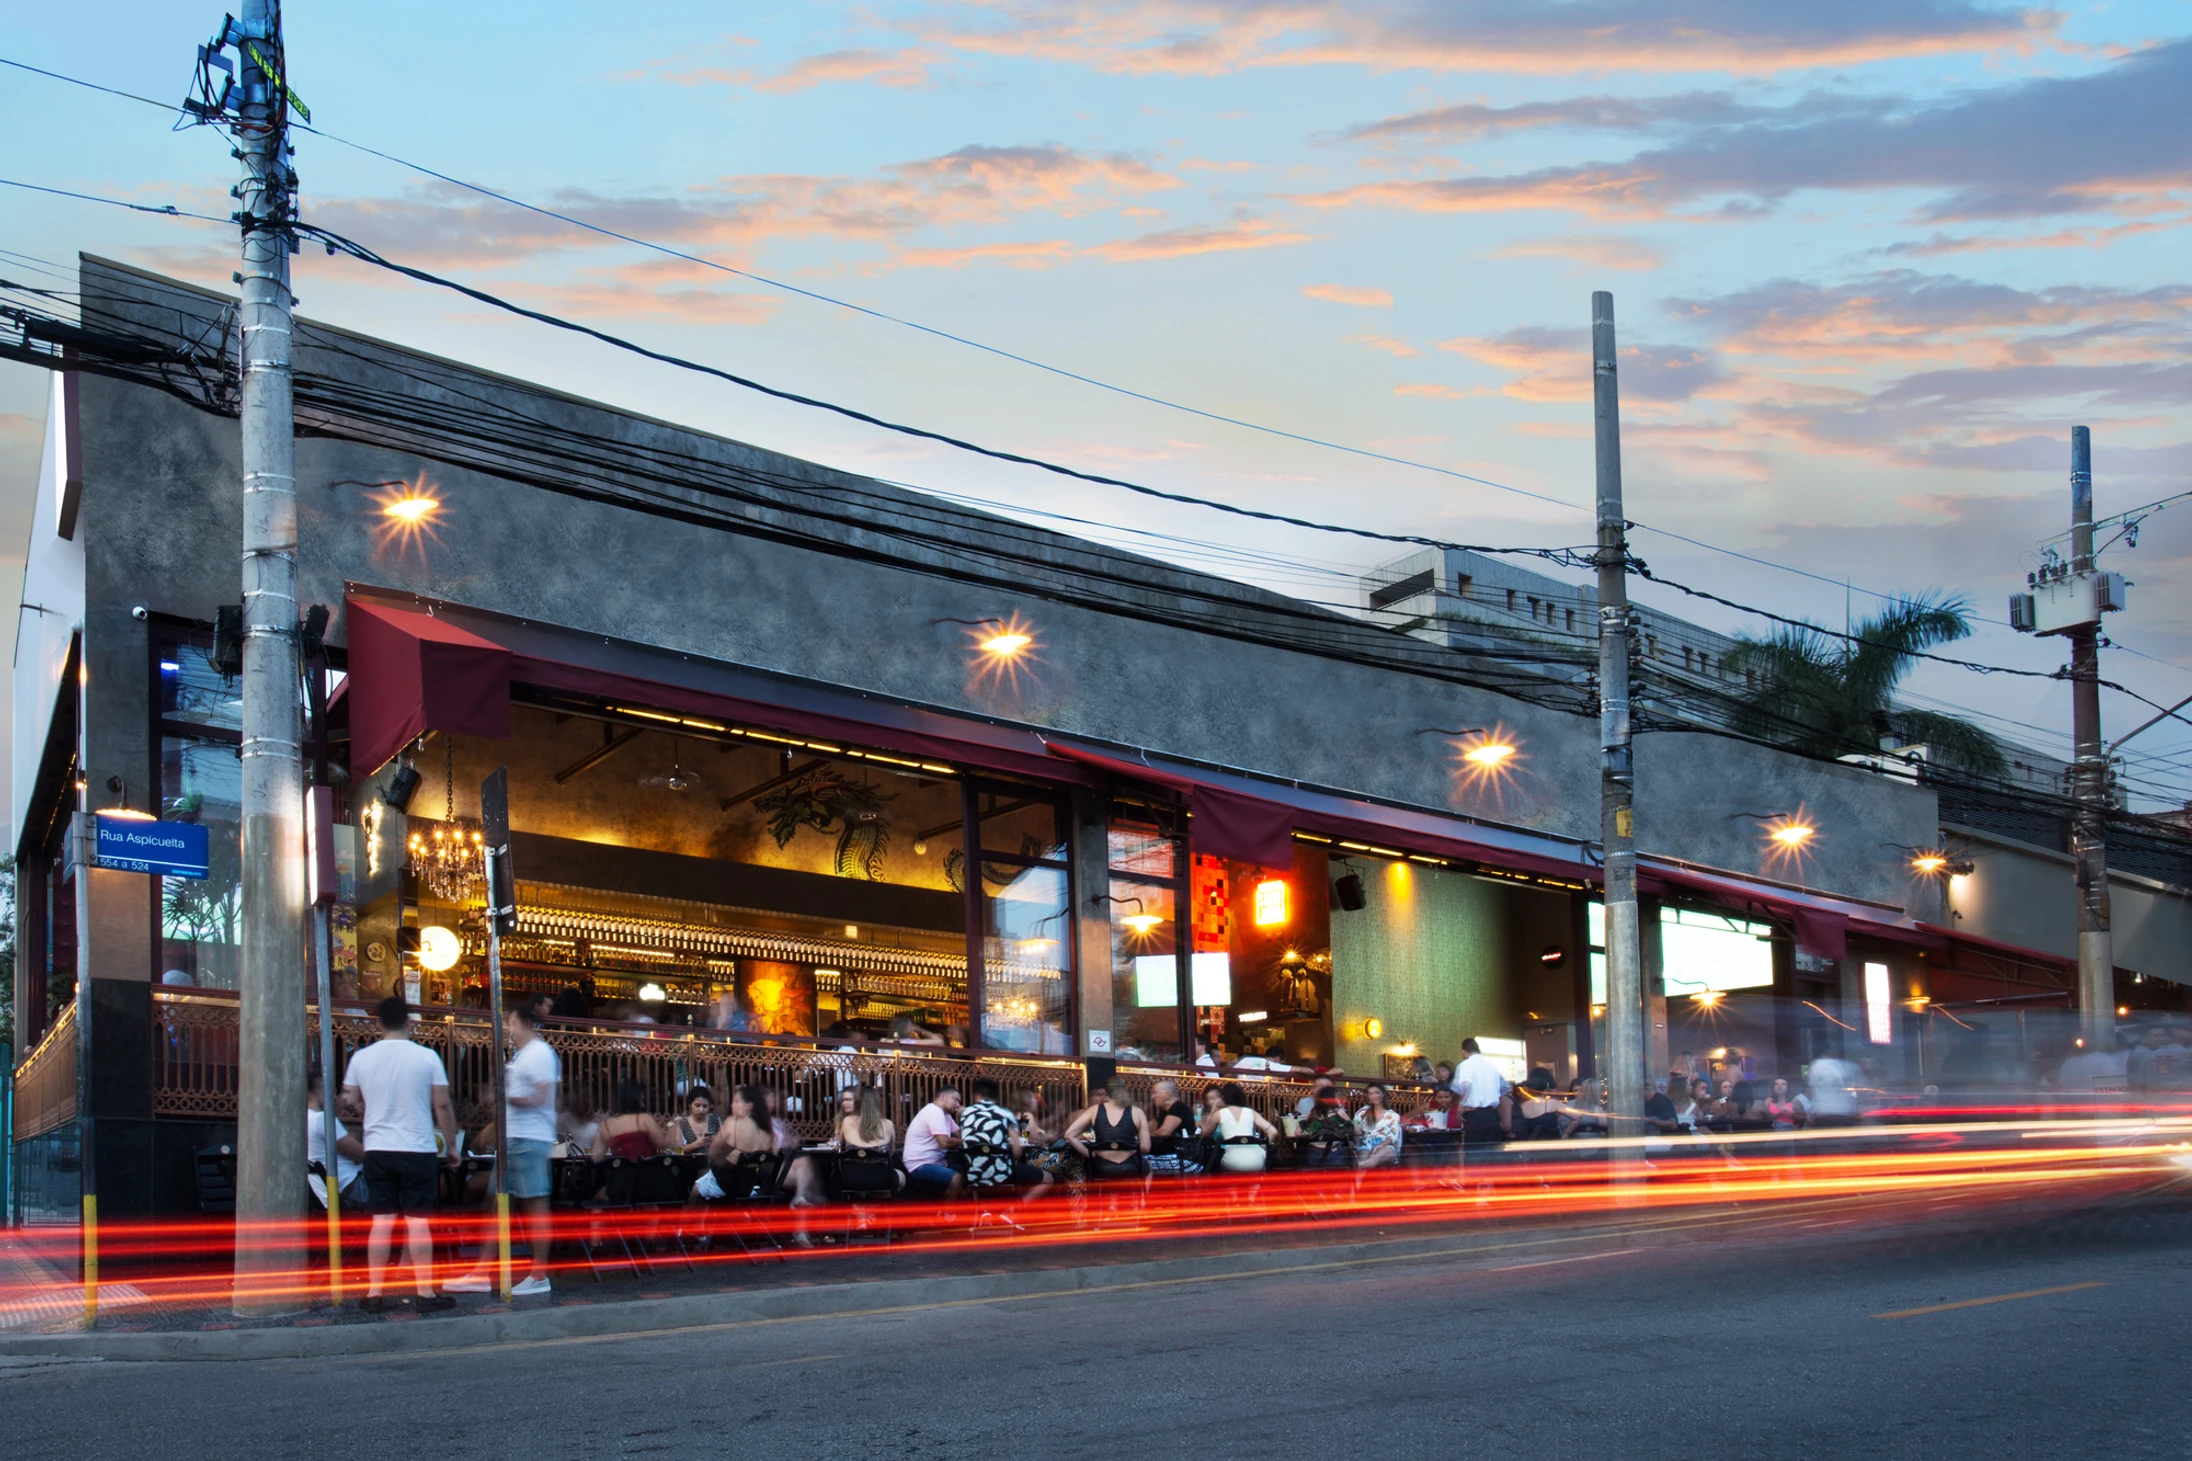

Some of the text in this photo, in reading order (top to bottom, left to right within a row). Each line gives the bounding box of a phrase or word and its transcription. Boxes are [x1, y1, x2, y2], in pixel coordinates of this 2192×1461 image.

[100, 829, 185, 848] Rua Aspicuelta
[100, 858, 118, 868] 554
[131, 861, 149, 871] 524
